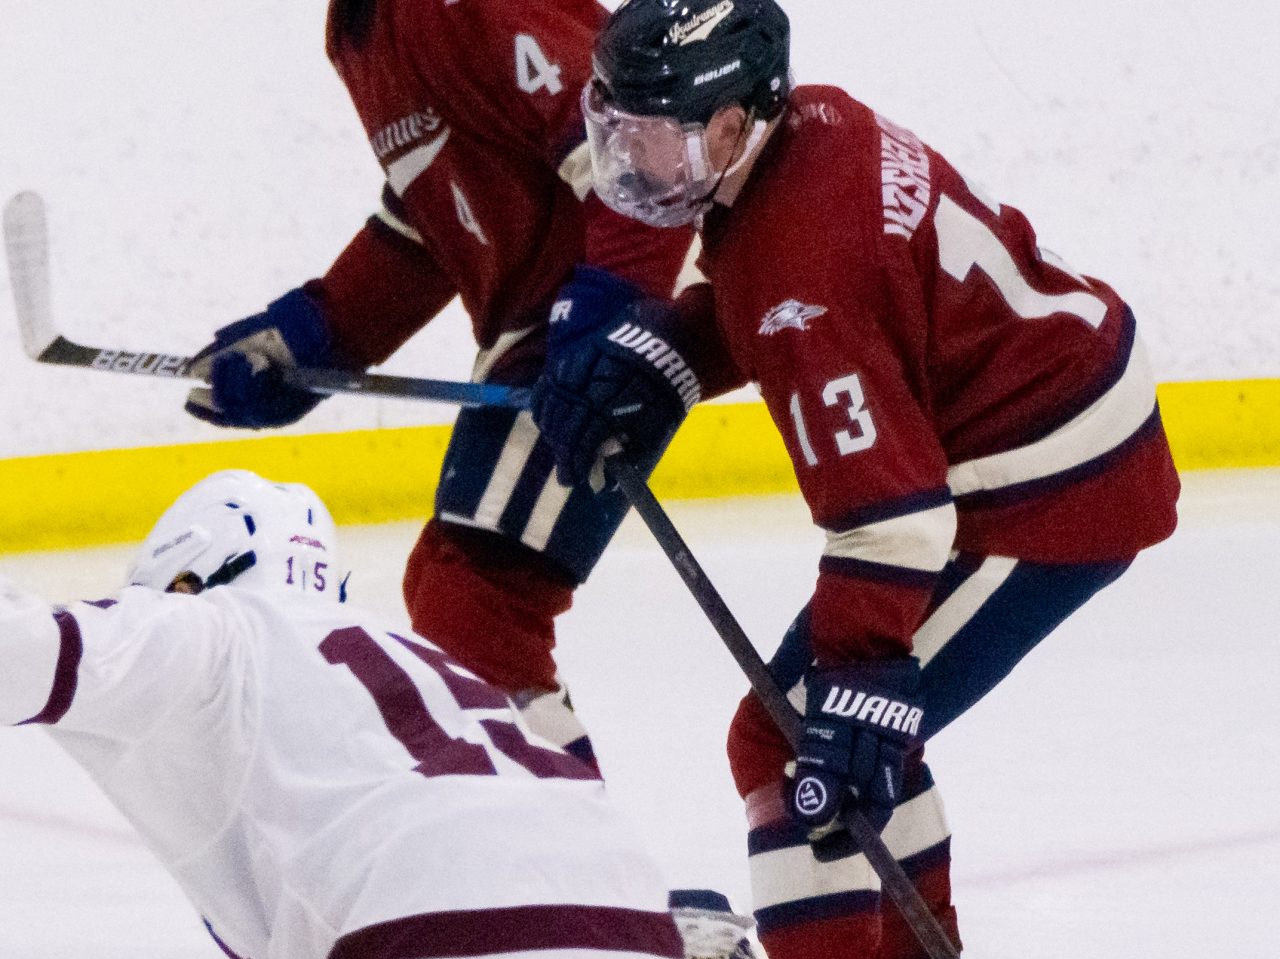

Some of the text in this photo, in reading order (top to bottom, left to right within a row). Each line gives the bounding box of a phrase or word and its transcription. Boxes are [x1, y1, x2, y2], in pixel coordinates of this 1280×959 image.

[514, 33, 563, 97] 4
[693, 60, 741, 86] BAUER
[790, 372, 877, 468] 13
[286, 556, 328, 592] 15
[319, 625, 605, 783] 15
